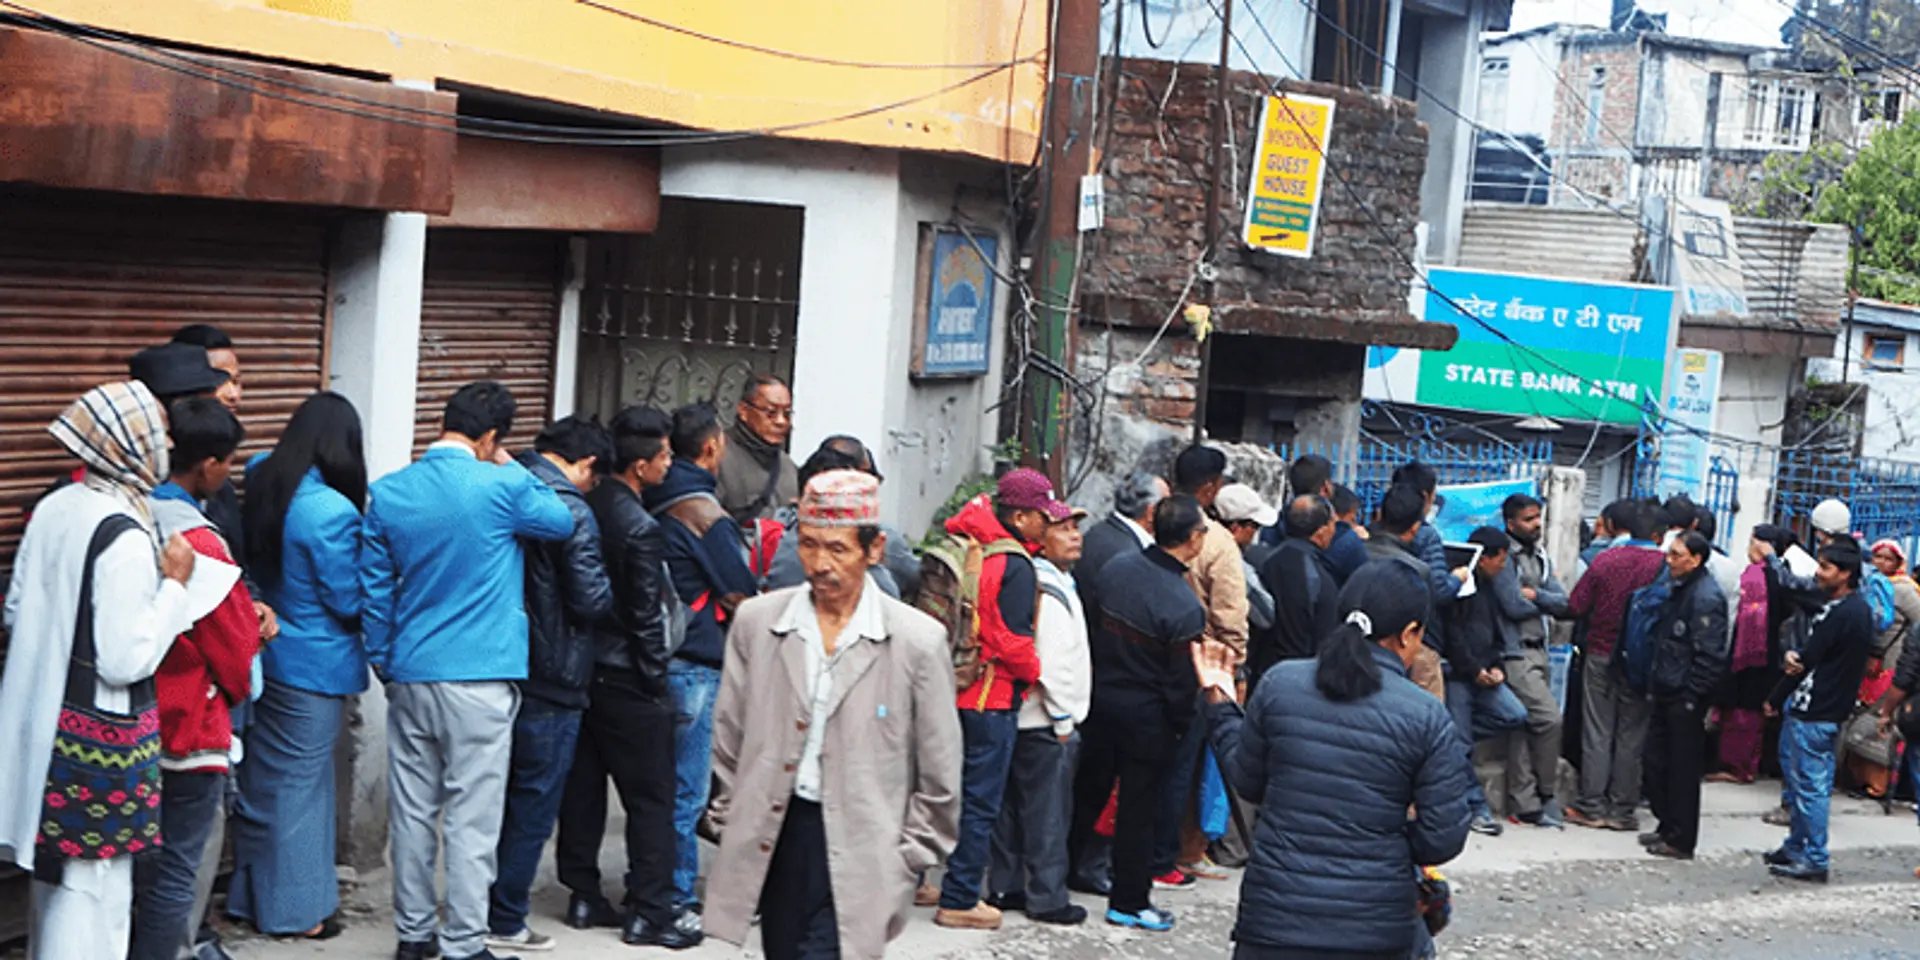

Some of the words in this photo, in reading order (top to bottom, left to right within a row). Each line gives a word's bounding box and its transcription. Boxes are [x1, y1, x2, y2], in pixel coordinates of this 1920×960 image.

[1266, 153, 1309, 175] GUEST
[1263, 176, 1308, 197] HOUSE
[1552, 307, 1569, 328] ए
[1576, 304, 1600, 328] टी
[1607, 313, 1642, 334] एम
[1445, 363, 1514, 388] STATE
[1521, 371, 1582, 395] BANK
[1588, 379, 1638, 402] ATM
